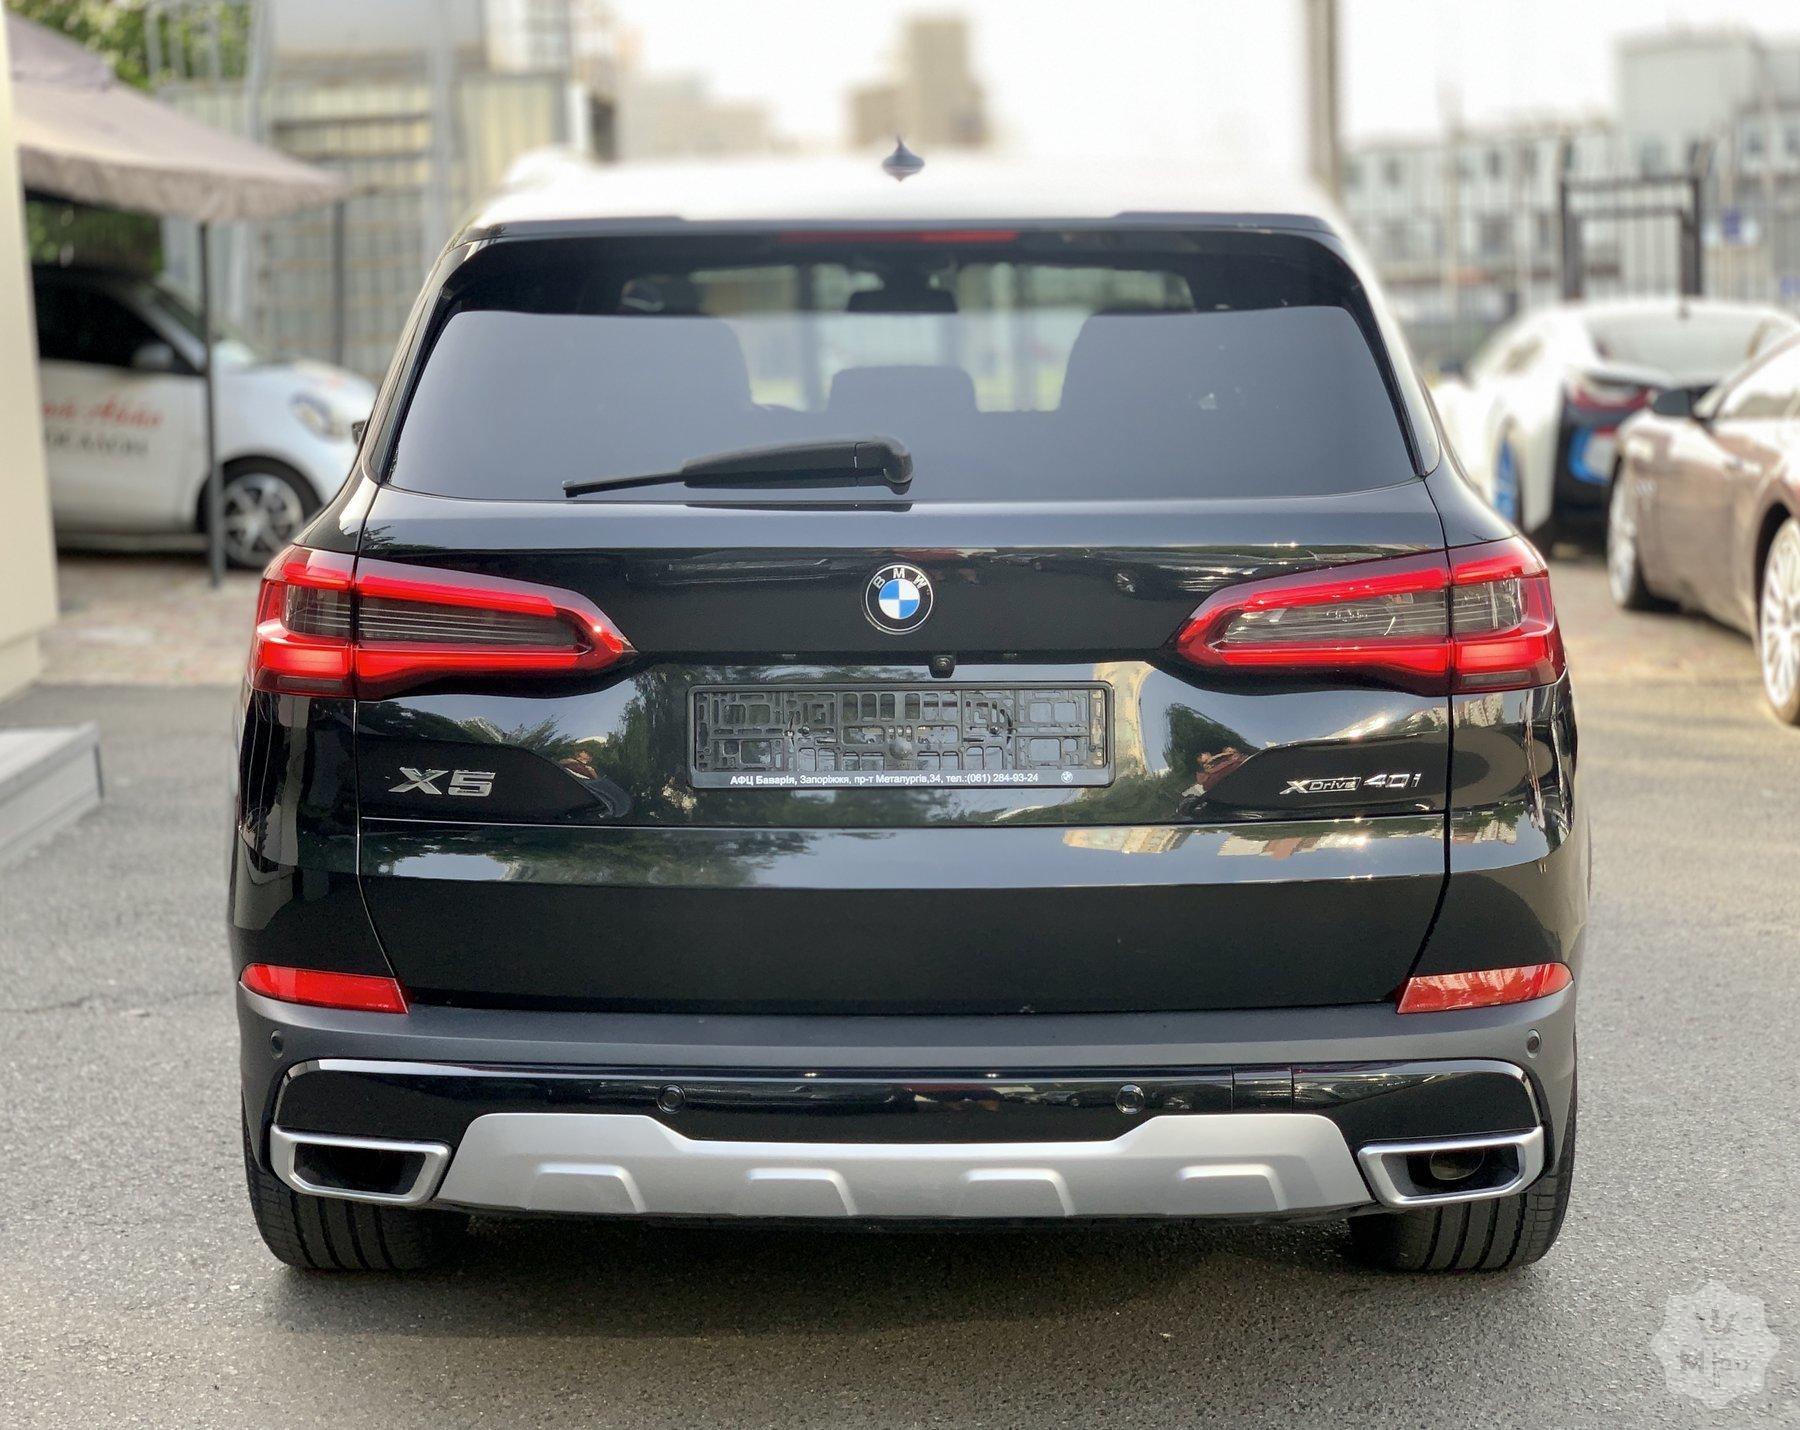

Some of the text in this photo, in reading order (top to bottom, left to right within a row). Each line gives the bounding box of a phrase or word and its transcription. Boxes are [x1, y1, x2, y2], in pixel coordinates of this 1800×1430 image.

[872, 567, 928, 590] BMW
[388, 767, 496, 797] X5
[730, 775, 754, 786] АФЦ
[756, 775, 798, 786] Баварія,
[800, 774, 852, 785] Запоріжжя,
[855, 776, 874, 785] пр-т
[993, 772, 1039, 783] 284-93-24
